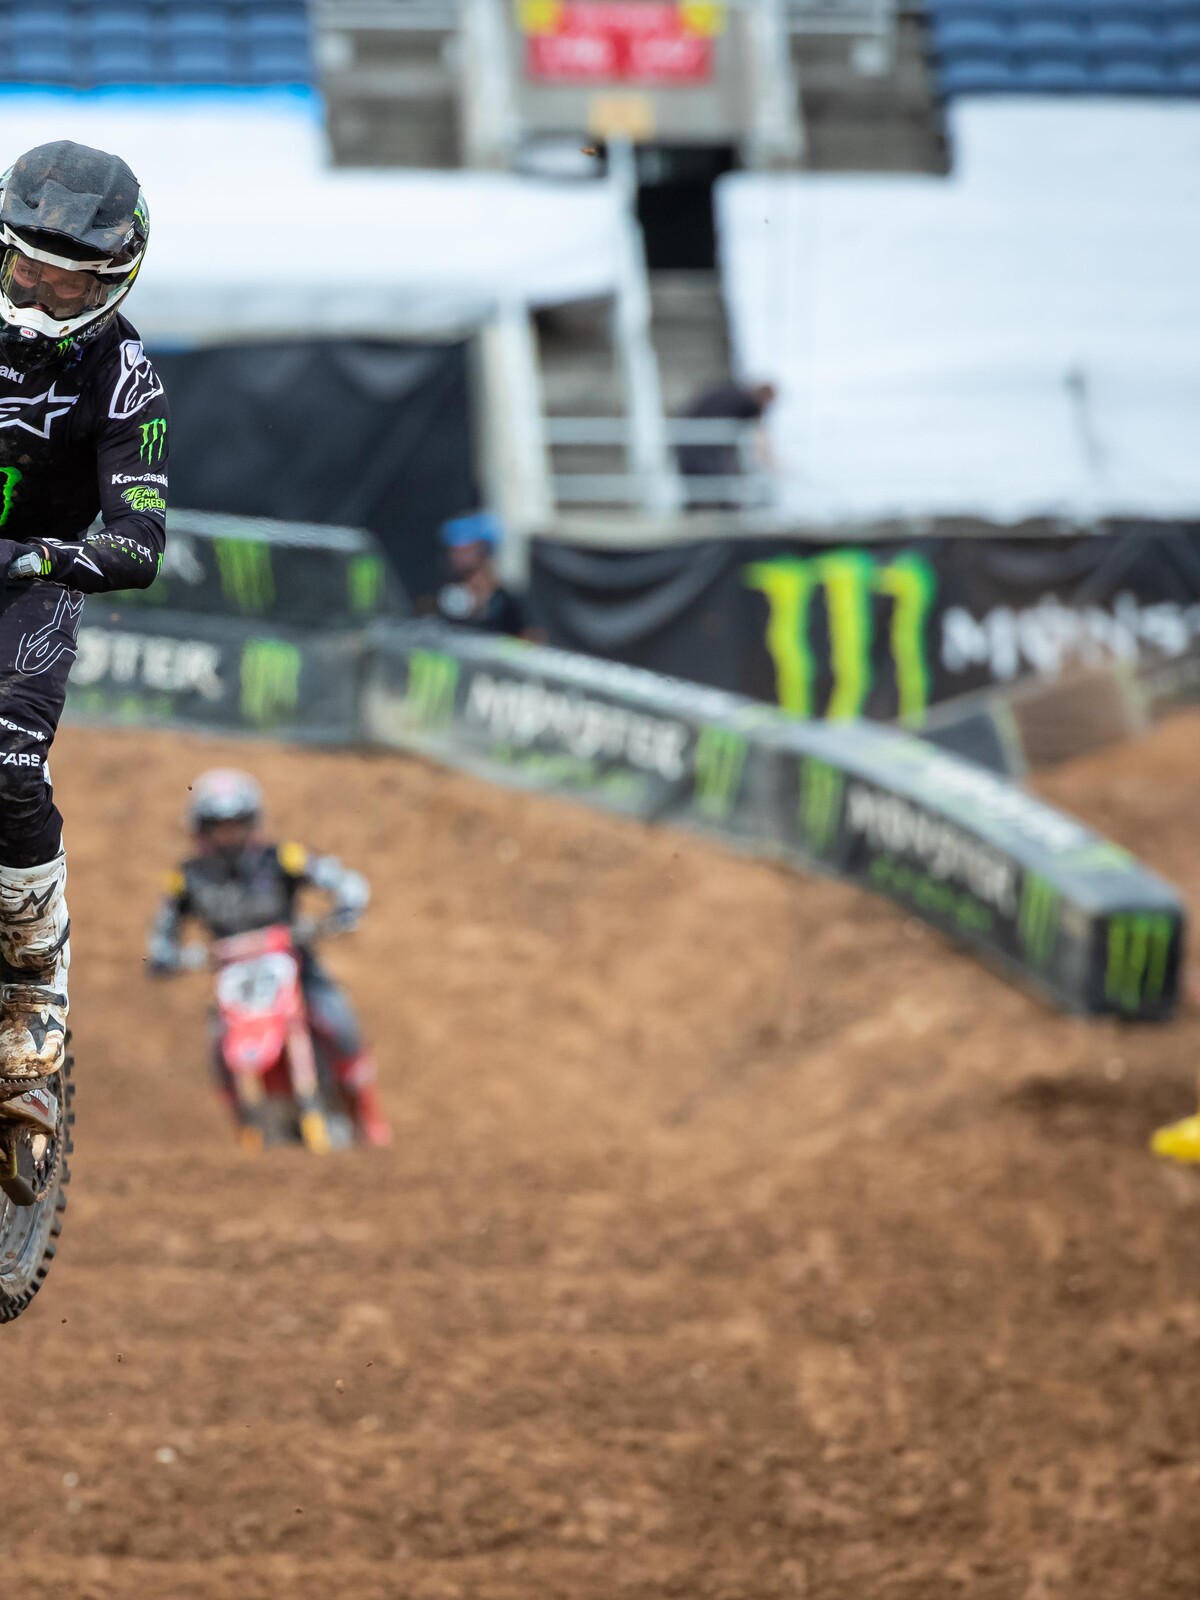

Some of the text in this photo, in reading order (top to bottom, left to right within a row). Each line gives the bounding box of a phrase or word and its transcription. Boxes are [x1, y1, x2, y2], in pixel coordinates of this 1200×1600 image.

[121, 485, 159, 503] TEAM
[131, 498, 166, 513] GREEN
[81, 533, 154, 563] ONSTER
